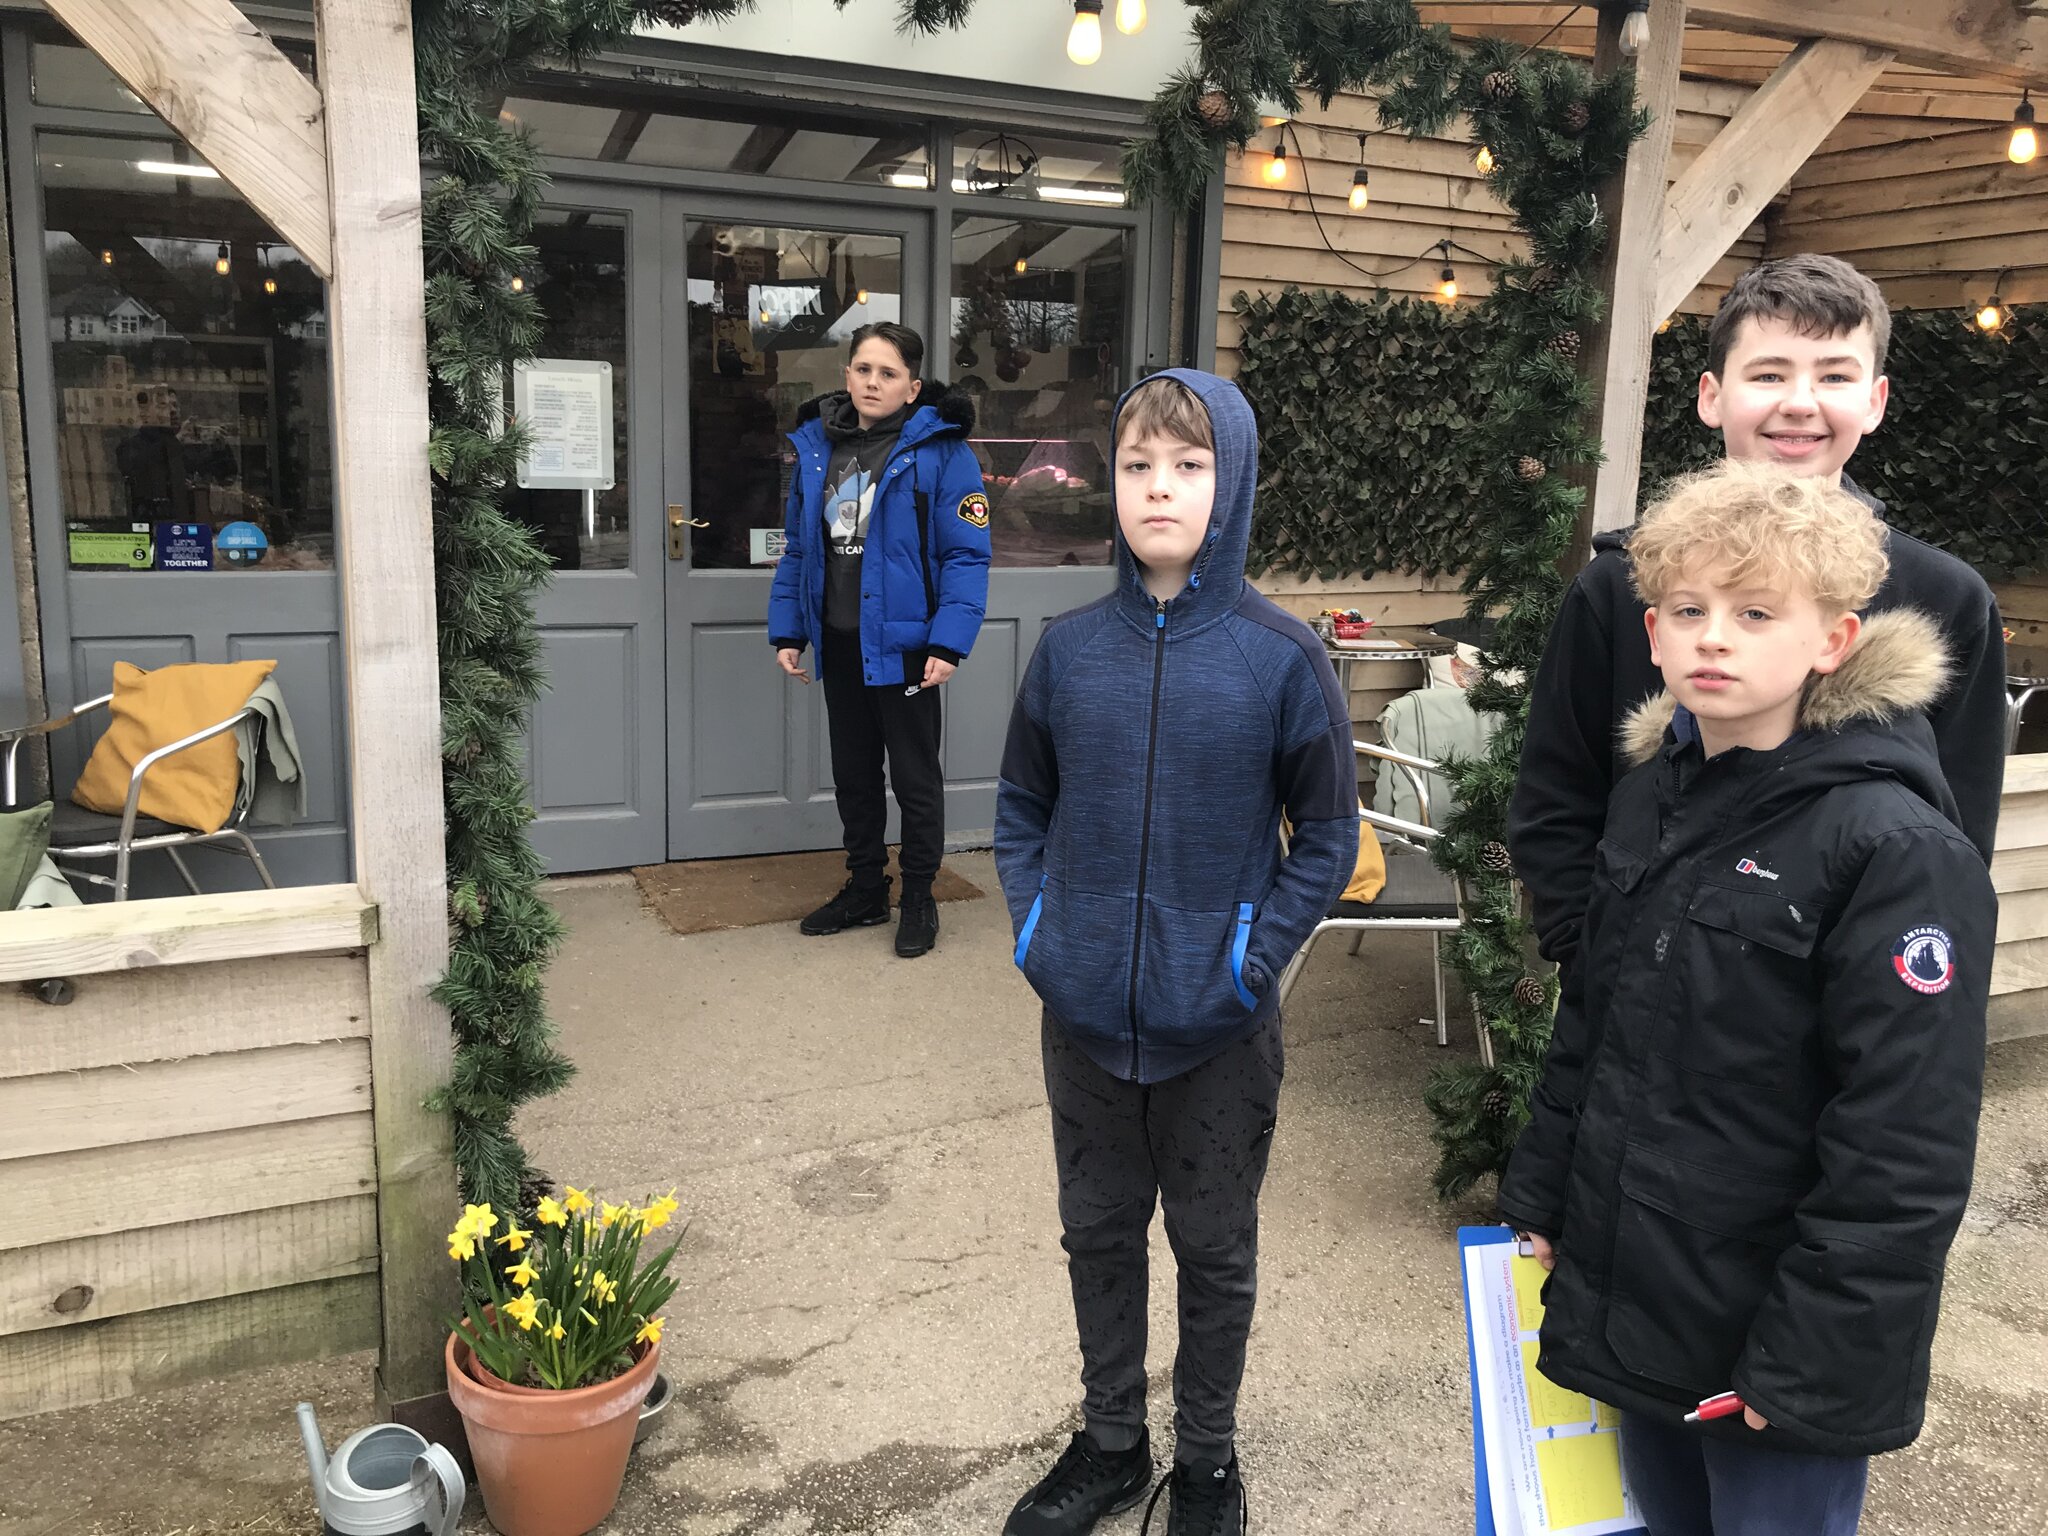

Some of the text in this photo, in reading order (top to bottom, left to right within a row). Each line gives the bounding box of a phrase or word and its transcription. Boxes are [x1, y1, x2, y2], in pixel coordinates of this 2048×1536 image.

[762, 285, 825, 316] OPEN
[1751, 864, 1780, 881] berghaus
[1902, 927, 1951, 949] ANTARCTICA
[1900, 971, 1950, 993] EXPEDITION
[1502, 1260, 1512, 1292] system
[1498, 1294, 1507, 1338] diagram
[1506, 1295, 1516, 1342] economic
[1512, 1344, 1518, 1358] an
[1506, 1350, 1514, 1380] make
[1515, 1360, 1520, 1372] as
[1510, 1382, 1516, 1394] to
[1517, 1374, 1526, 1404] works
[1513, 1396, 1521, 1425] going
[1525, 1474, 1531, 1492] We
[1532, 1470, 1541, 1500] shows
[1537, 1504, 1545, 1527] that
